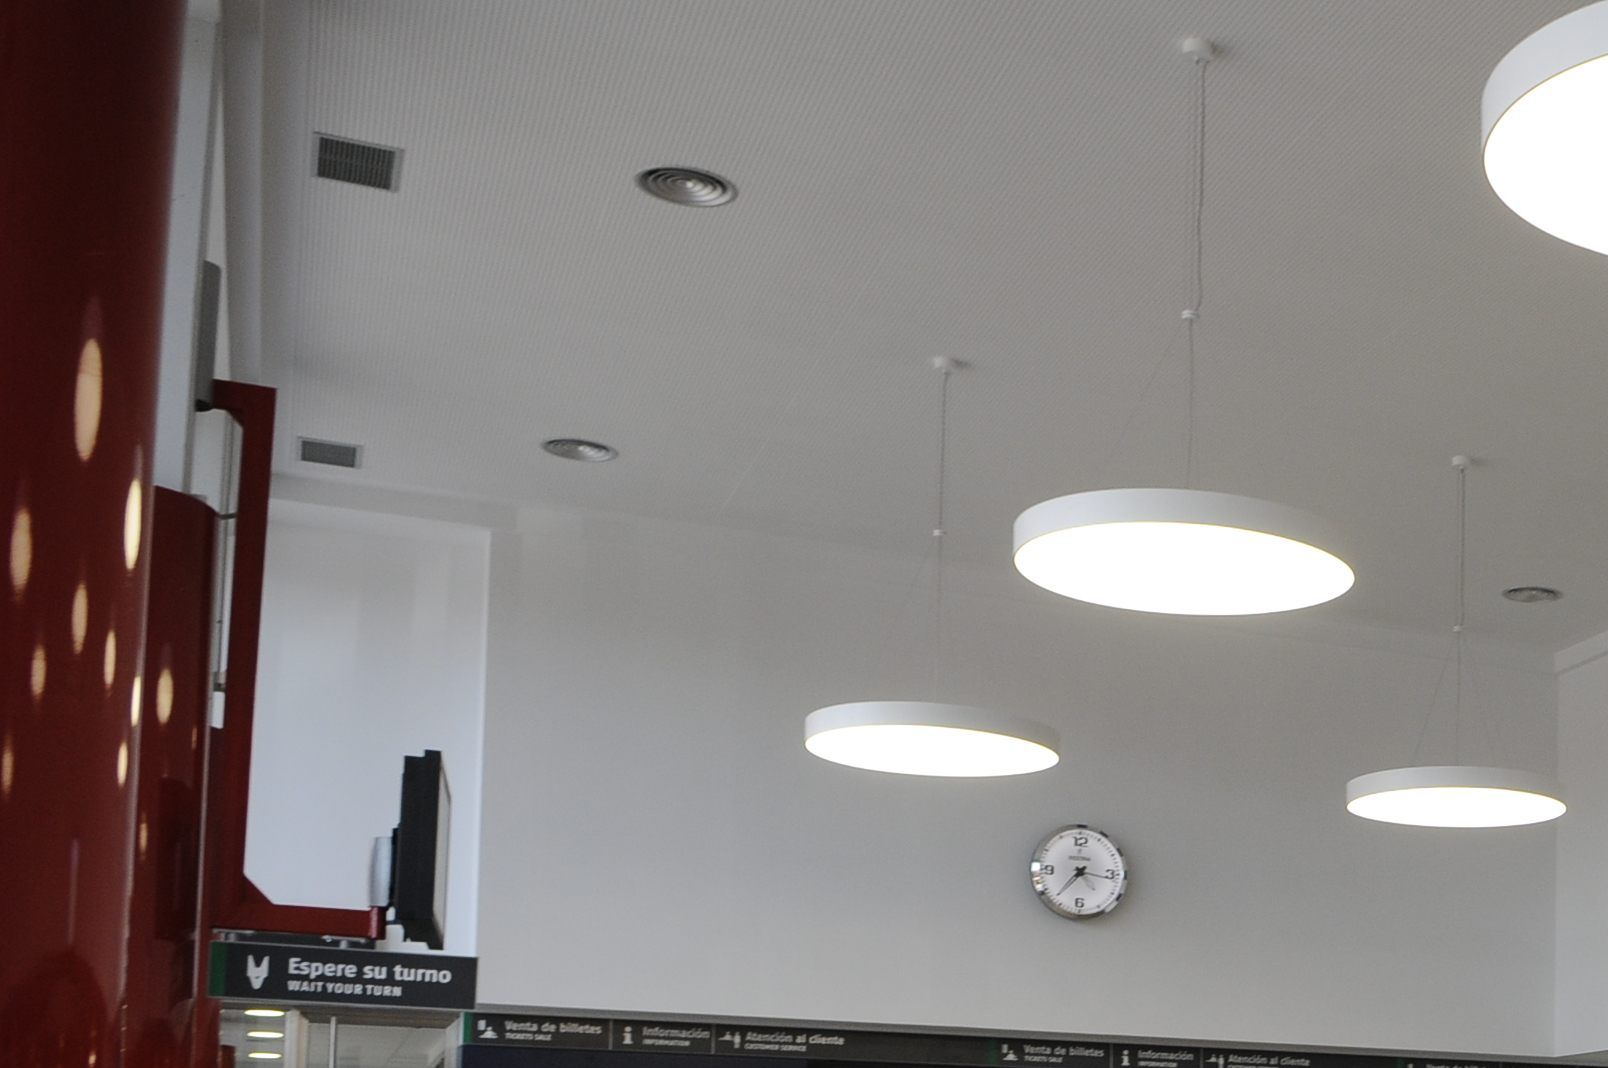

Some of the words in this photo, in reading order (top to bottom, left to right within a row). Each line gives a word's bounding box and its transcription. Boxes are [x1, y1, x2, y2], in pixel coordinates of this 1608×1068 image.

[1073, 836, 1088, 847] 12
[1044, 865, 1054, 875] 9
[1105, 869, 1115, 879] 3
[1075, 897, 1085, 908] 6
[288, 957, 357, 980] Espere
[362, 964, 388, 980] su
[393, 963, 453, 984] turno
[287, 980, 323, 993] WAIT
[325, 981, 364, 995] YOUR
[365, 984, 403, 997] TURN
[504, 1020, 539, 1032] Venta
[541, 1021, 557, 1032] de
[559, 1021, 603, 1035] billetes
[642, 1026, 711, 1039] Información
[745, 1031, 793, 1043] Atención
[795, 1033, 807, 1043] al
[808, 1033, 845, 1046] cliente
[1023, 1044, 1051, 1055] Venta
[1053, 1045, 1067, 1056] de
[1068, 1045, 1104, 1058] billetes
[1137, 1050, 1194, 1061] Información
[1227, 1054, 1267, 1065] Atención
[1269, 1055, 1278, 1065] al
[1280, 1056, 1311, 1067] cliente
